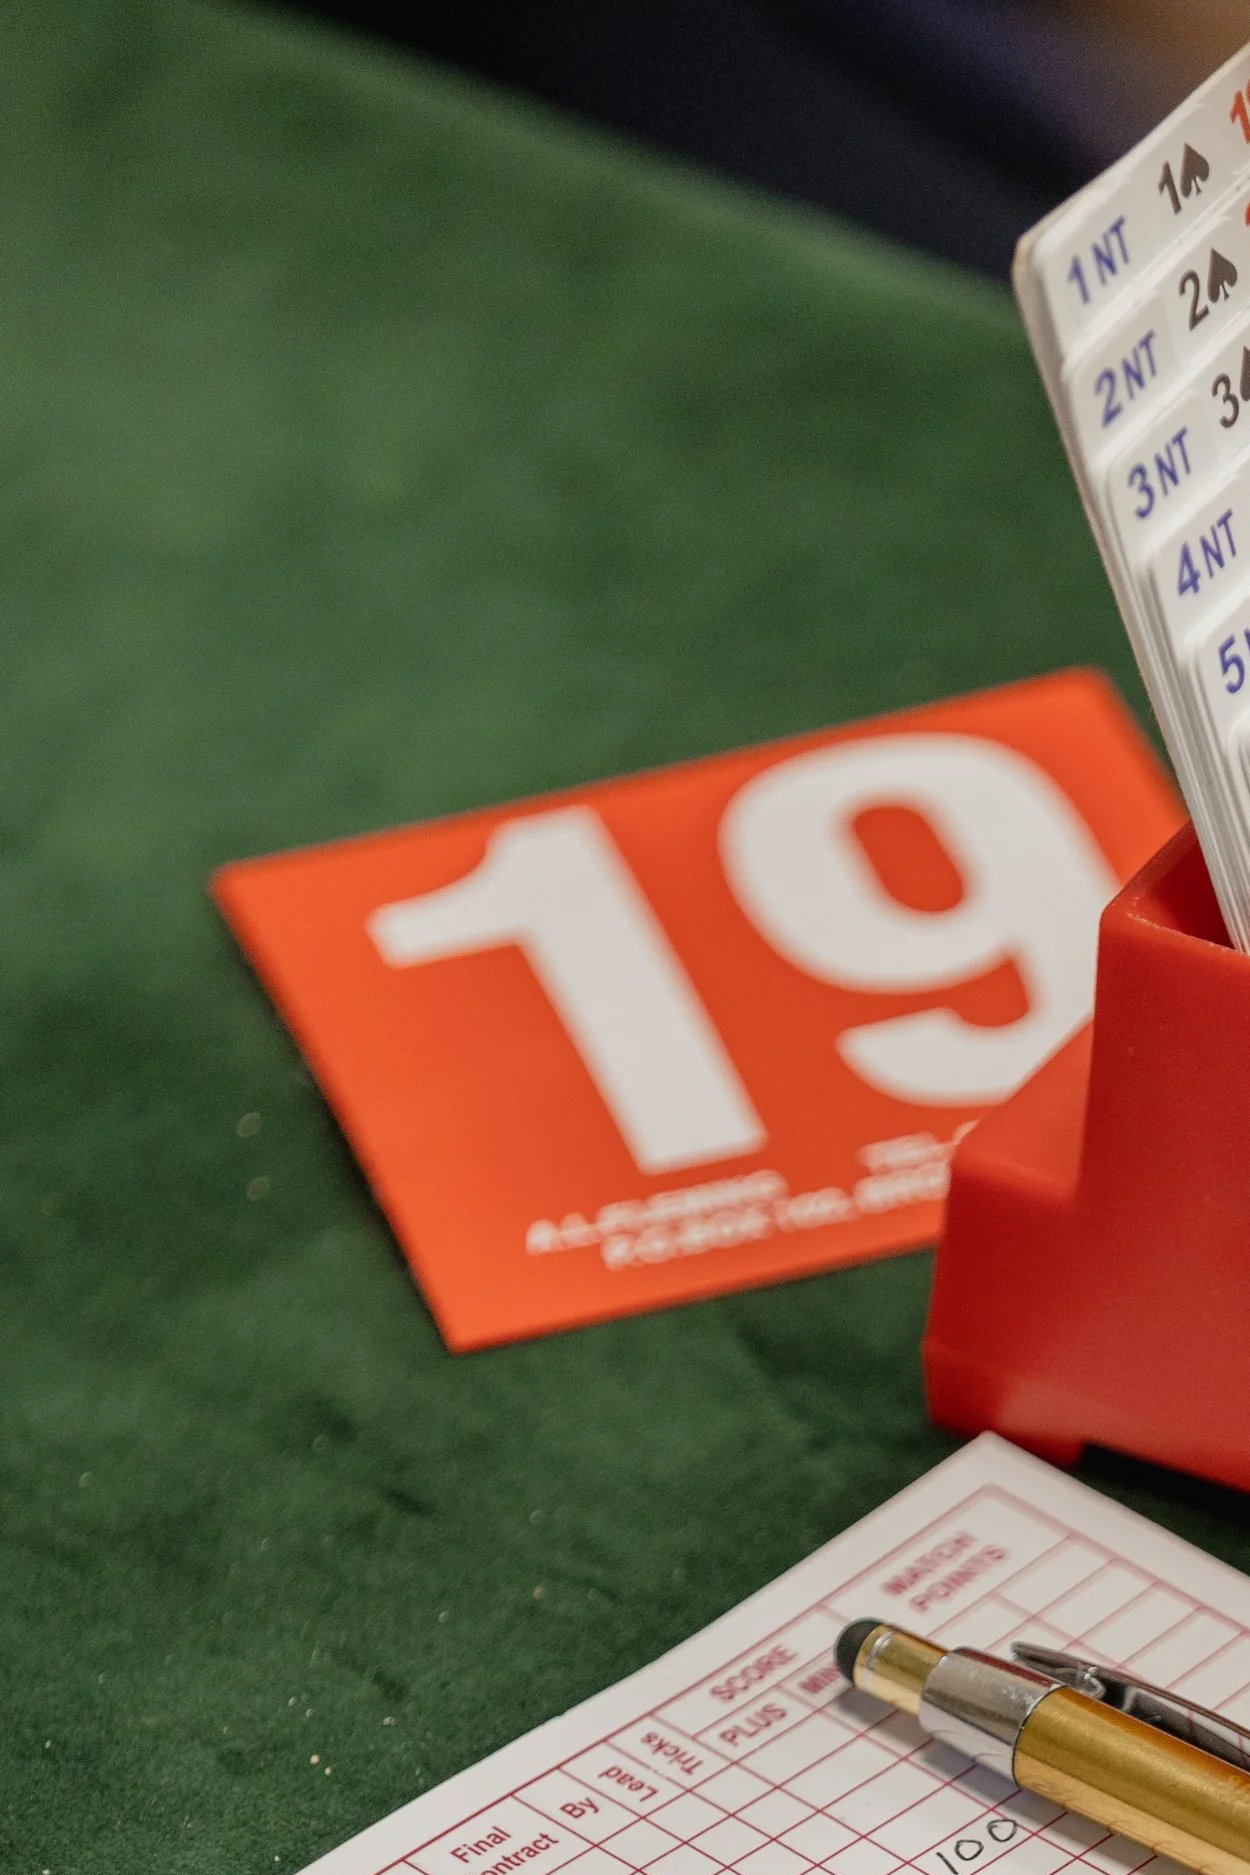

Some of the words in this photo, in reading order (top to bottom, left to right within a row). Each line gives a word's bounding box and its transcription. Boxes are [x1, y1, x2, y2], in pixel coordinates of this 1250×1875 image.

[366, 731, 1123, 1175] 19
[882, 1530, 975, 1596] MATCH
[910, 1545, 1006, 1613] POINTS
[709, 1643, 798, 1703] SCORE
[718, 1702, 788, 1748] PLUS
[640, 1731, 703, 1776] Tricks
[559, 1797, 600, 1819] By
[597, 1766, 658, 1802] Lead
[449, 1826, 512, 1864] Final
[936, 1818, 1018, 1875] 100
